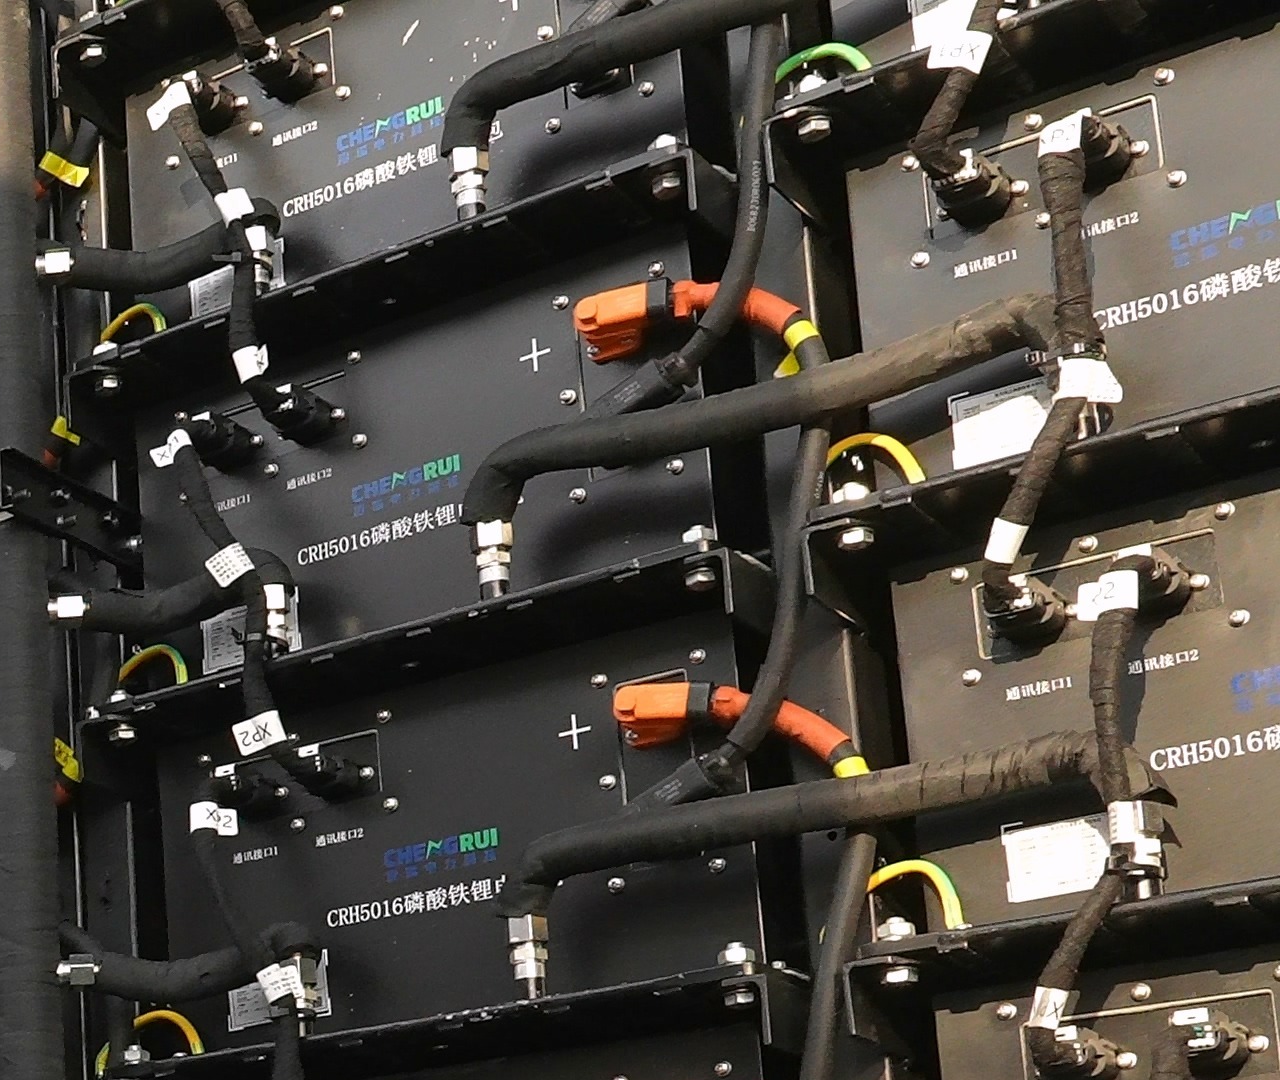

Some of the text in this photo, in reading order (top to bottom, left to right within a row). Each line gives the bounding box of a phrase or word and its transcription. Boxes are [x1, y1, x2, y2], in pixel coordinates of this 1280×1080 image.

[272, 121, 318, 147] 通讯接口2
[336, 96, 444, 151] CHENGRUI
[1169, 199, 1280, 252] CHENG
[954, 249, 1018, 279] 通讯接口1
[286, 467, 333, 490] 通讯接口2
[351, 453, 461, 501] CHENGRUI
[297, 503, 465, 566] CRH5016磷酸铁锂
[1128, 649, 1199, 675] 通讯接口2
[1006, 677, 1072, 702] 通讯接口1
[239, 721, 272, 747] XP2
[315, 828, 364, 848] 通讯接口2
[383, 827, 500, 869] CHENGRUI
[232, 846, 279, 865] 通讯接口1
